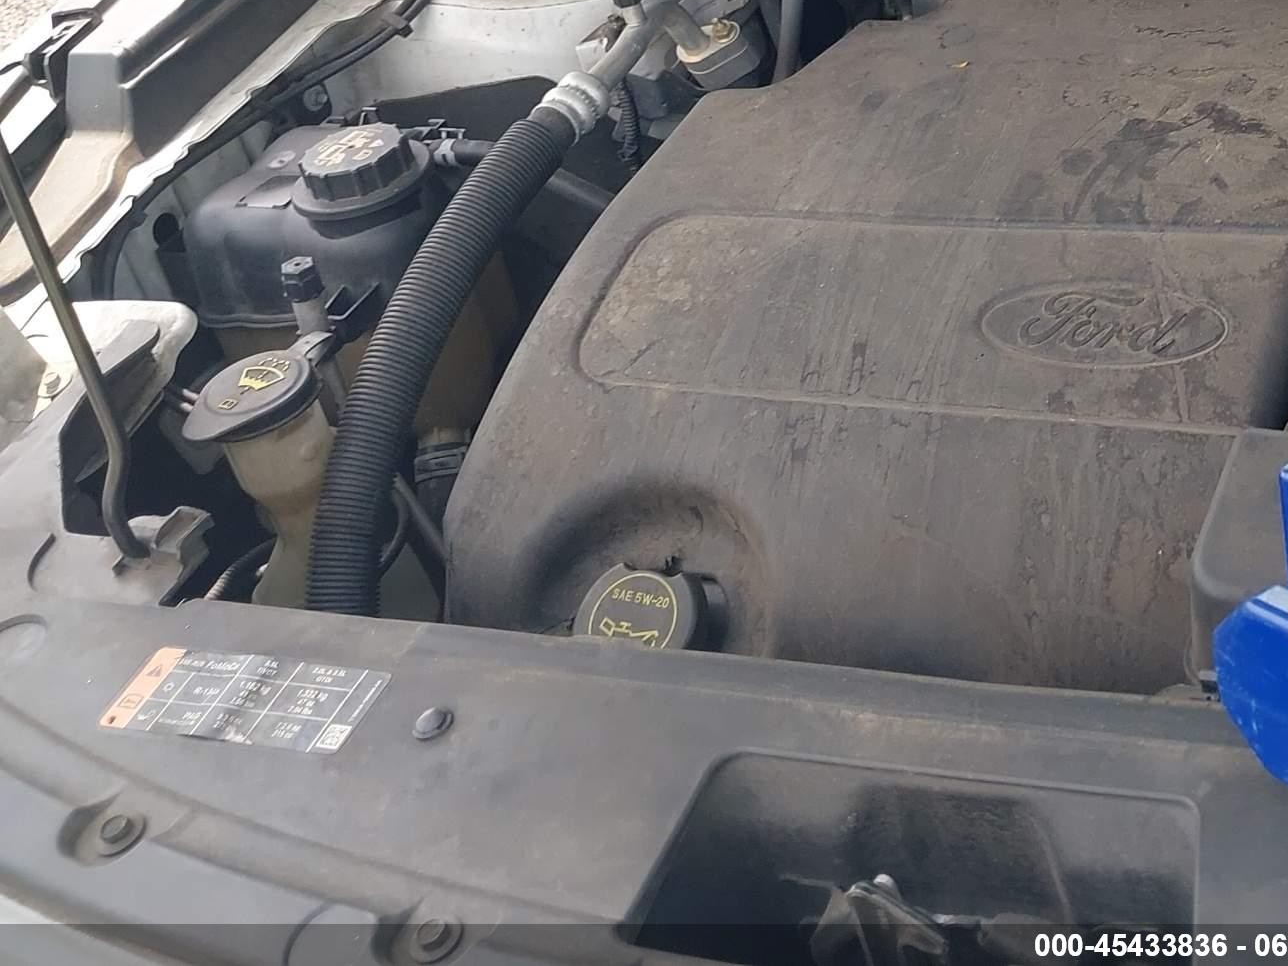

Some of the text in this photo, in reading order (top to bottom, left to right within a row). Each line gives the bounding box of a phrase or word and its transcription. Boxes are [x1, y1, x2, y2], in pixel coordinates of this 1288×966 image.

[1018, 290, 1189, 355] Ford
[611, 588, 670, 608] SAE 5W-20
